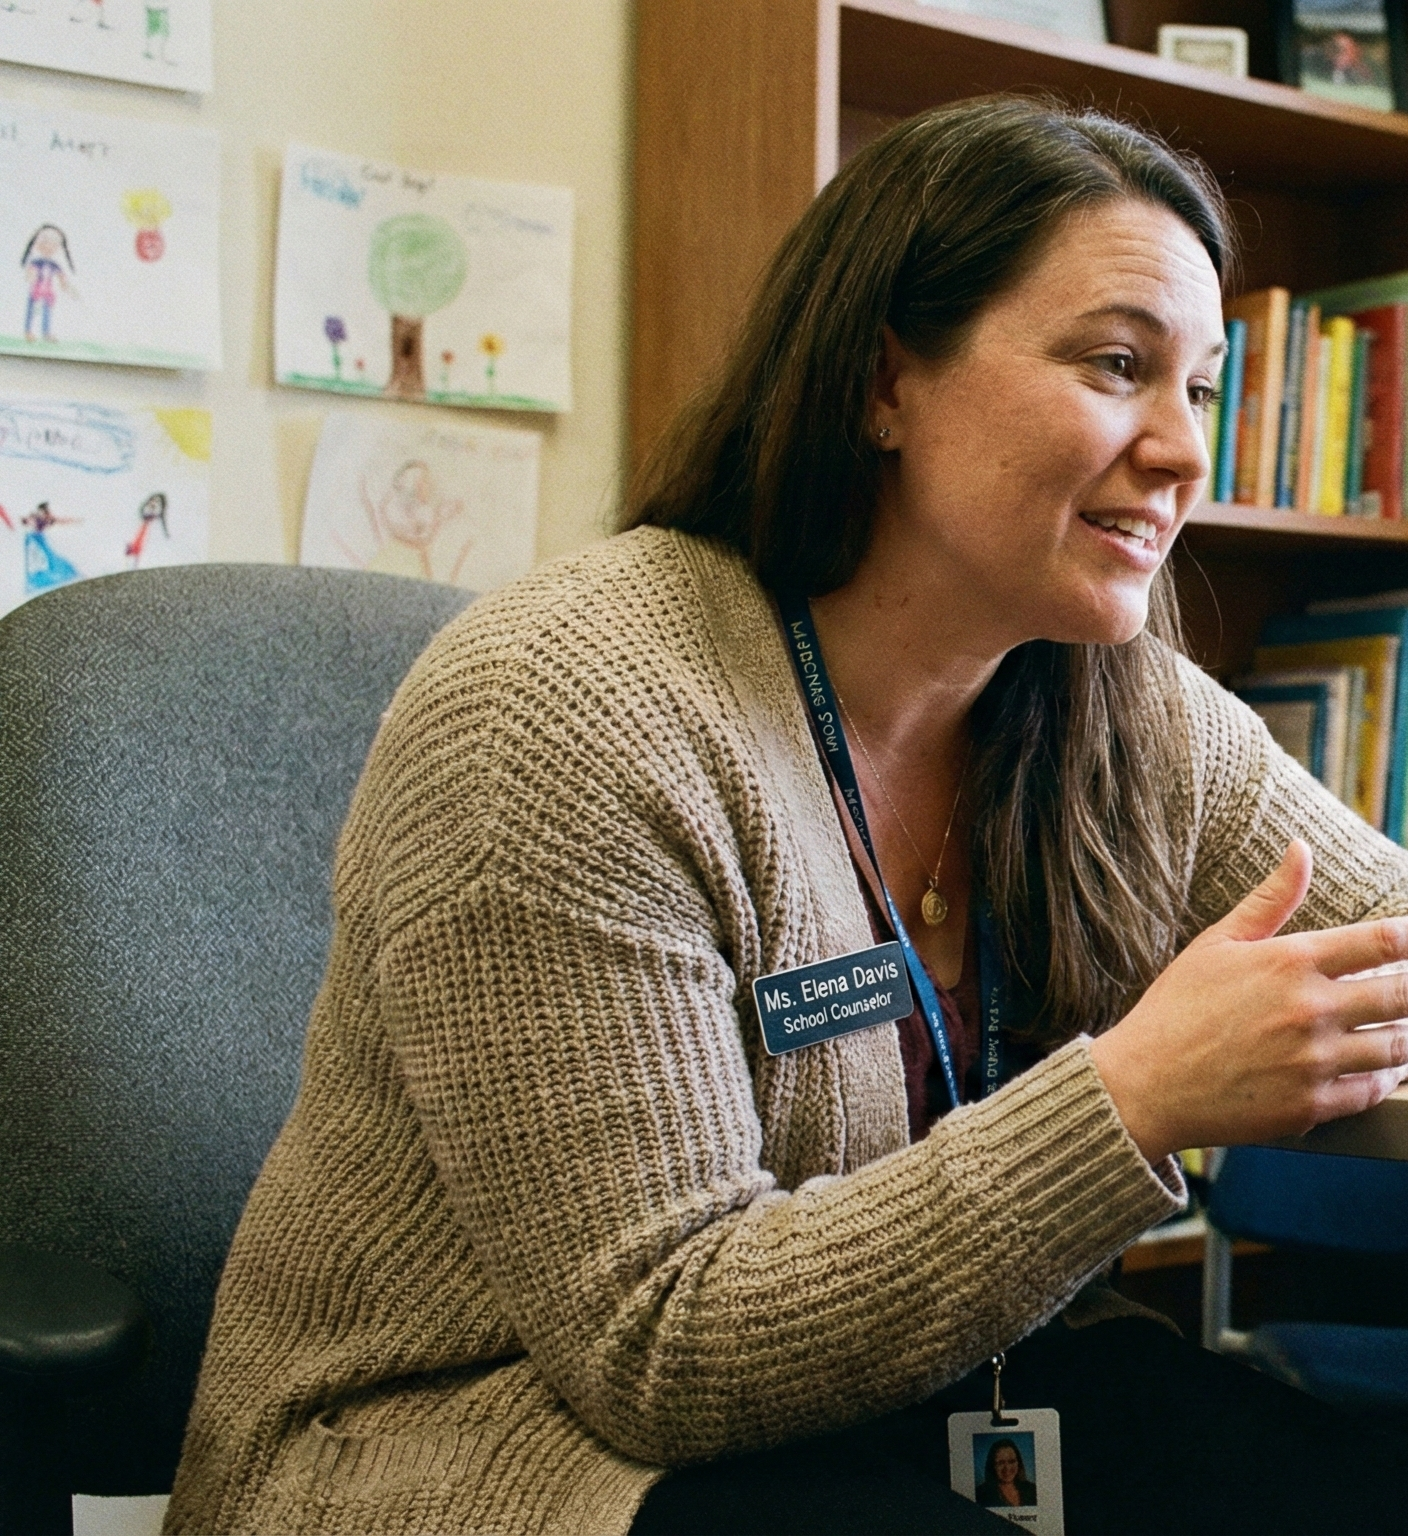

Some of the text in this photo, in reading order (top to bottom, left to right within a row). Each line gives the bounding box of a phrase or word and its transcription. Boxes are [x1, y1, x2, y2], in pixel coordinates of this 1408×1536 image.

[764, 958, 900, 1013] Ms. Elena Davis
[783, 991, 894, 1035] School Counselor
